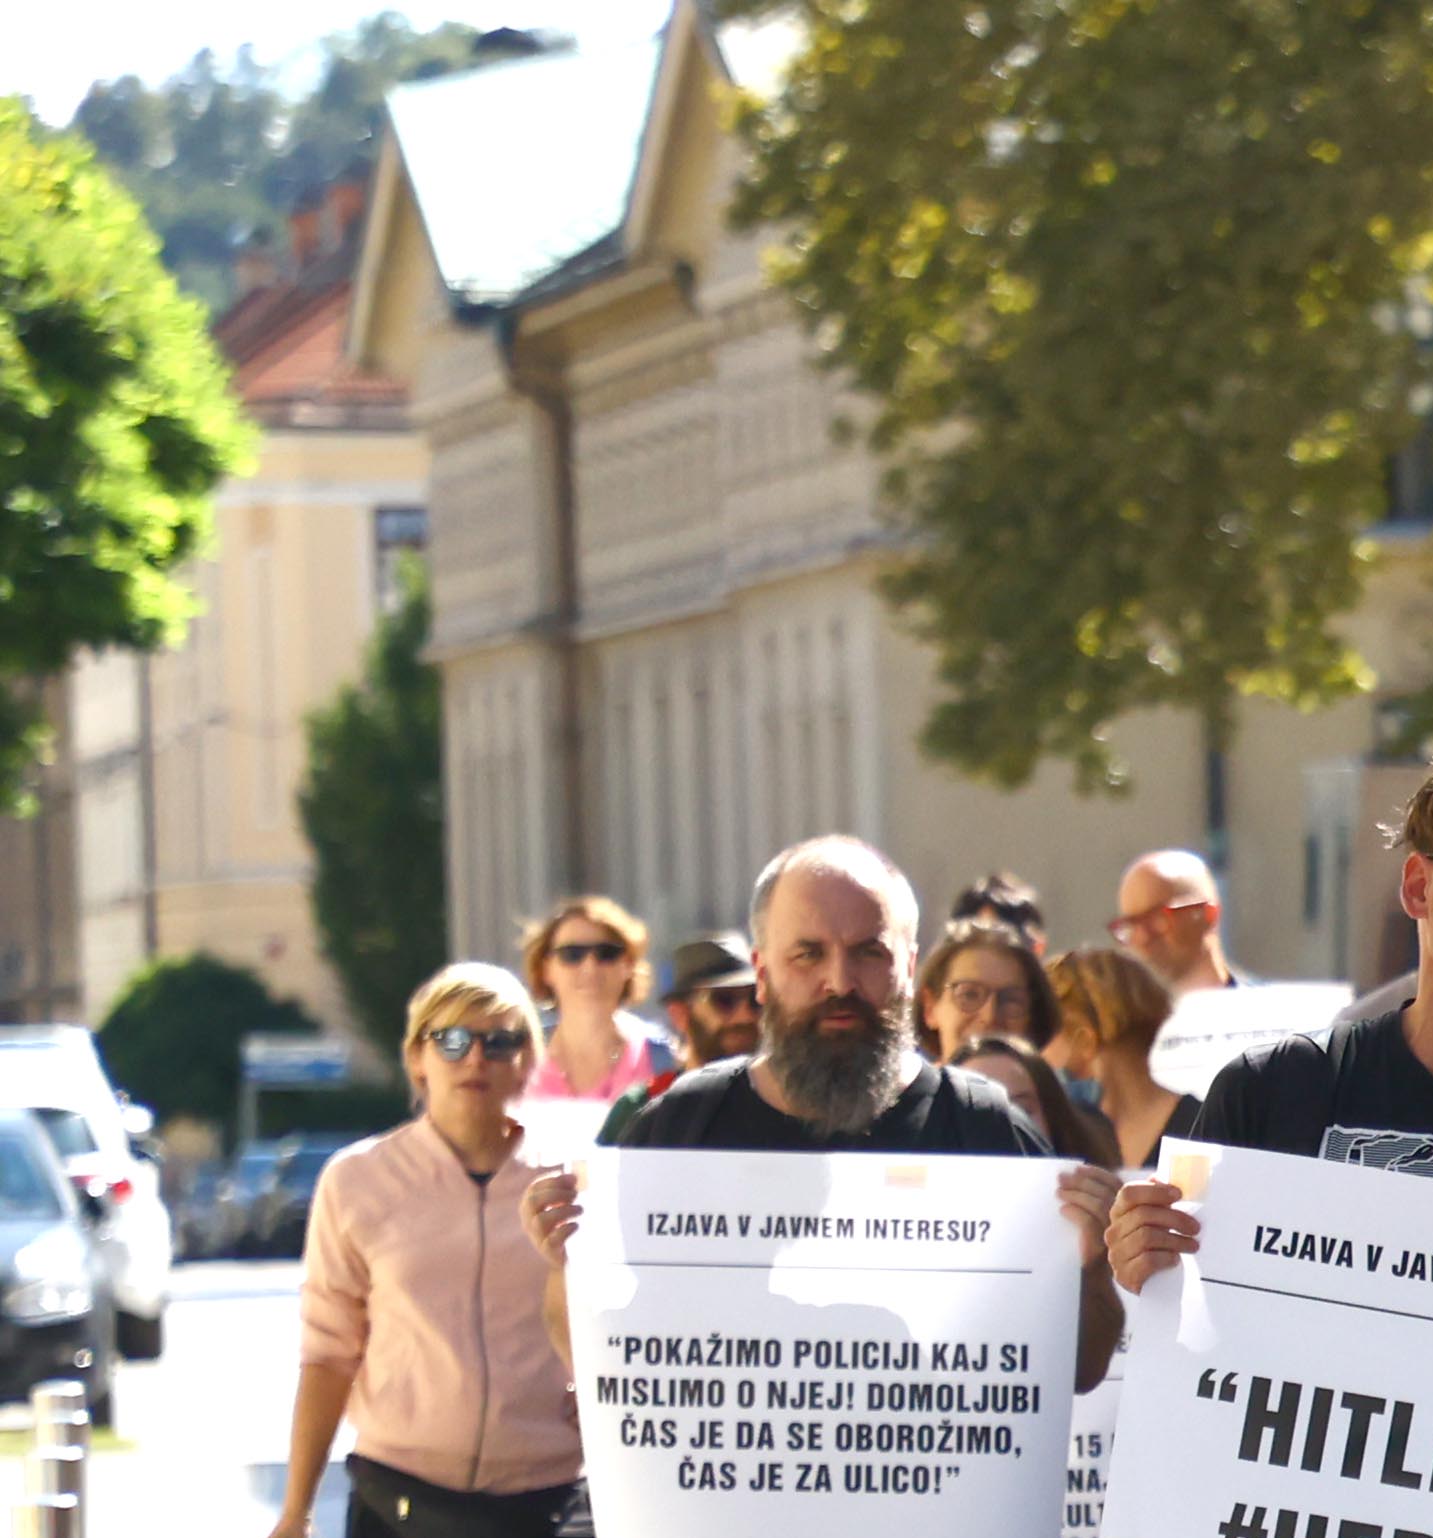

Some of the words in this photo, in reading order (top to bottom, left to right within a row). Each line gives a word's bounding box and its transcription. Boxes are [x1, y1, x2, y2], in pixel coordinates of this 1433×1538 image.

[647, 1212, 729, 1238] IZJAVA
[737, 1214, 752, 1238] V
[758, 1215, 855, 1239] JAVNEM
[865, 1218, 991, 1243] INTERESU?
[1253, 1225, 1353, 1269] IZJAVA
[1367, 1244, 1384, 1273] V
[607, 1332, 782, 1368] “POKAŽIMO
[793, 1339, 920, 1371] POLICIJI
[931, 1342, 989, 1373] KAJ
[999, 1343, 1029, 1373] SI
[596, 1375, 725, 1408] MISLIMO
[737, 1379, 756, 1409] O
[767, 1380, 854, 1411] NJEJ!
[867, 1382, 1041, 1414] DOMOLJUBI
[620, 1412, 678, 1449] ČAS
[689, 1420, 724, 1450] JE
[736, 1421, 775, 1451] DA
[786, 1421, 823, 1451] SE
[835, 1419, 1022, 1458] OBOROŽIMO,
[678, 1455, 737, 1491] ČAS
[748, 1462, 784, 1492] JE
[795, 1463, 832, 1493] ZA
[844, 1463, 960, 1495] ULICO!”
